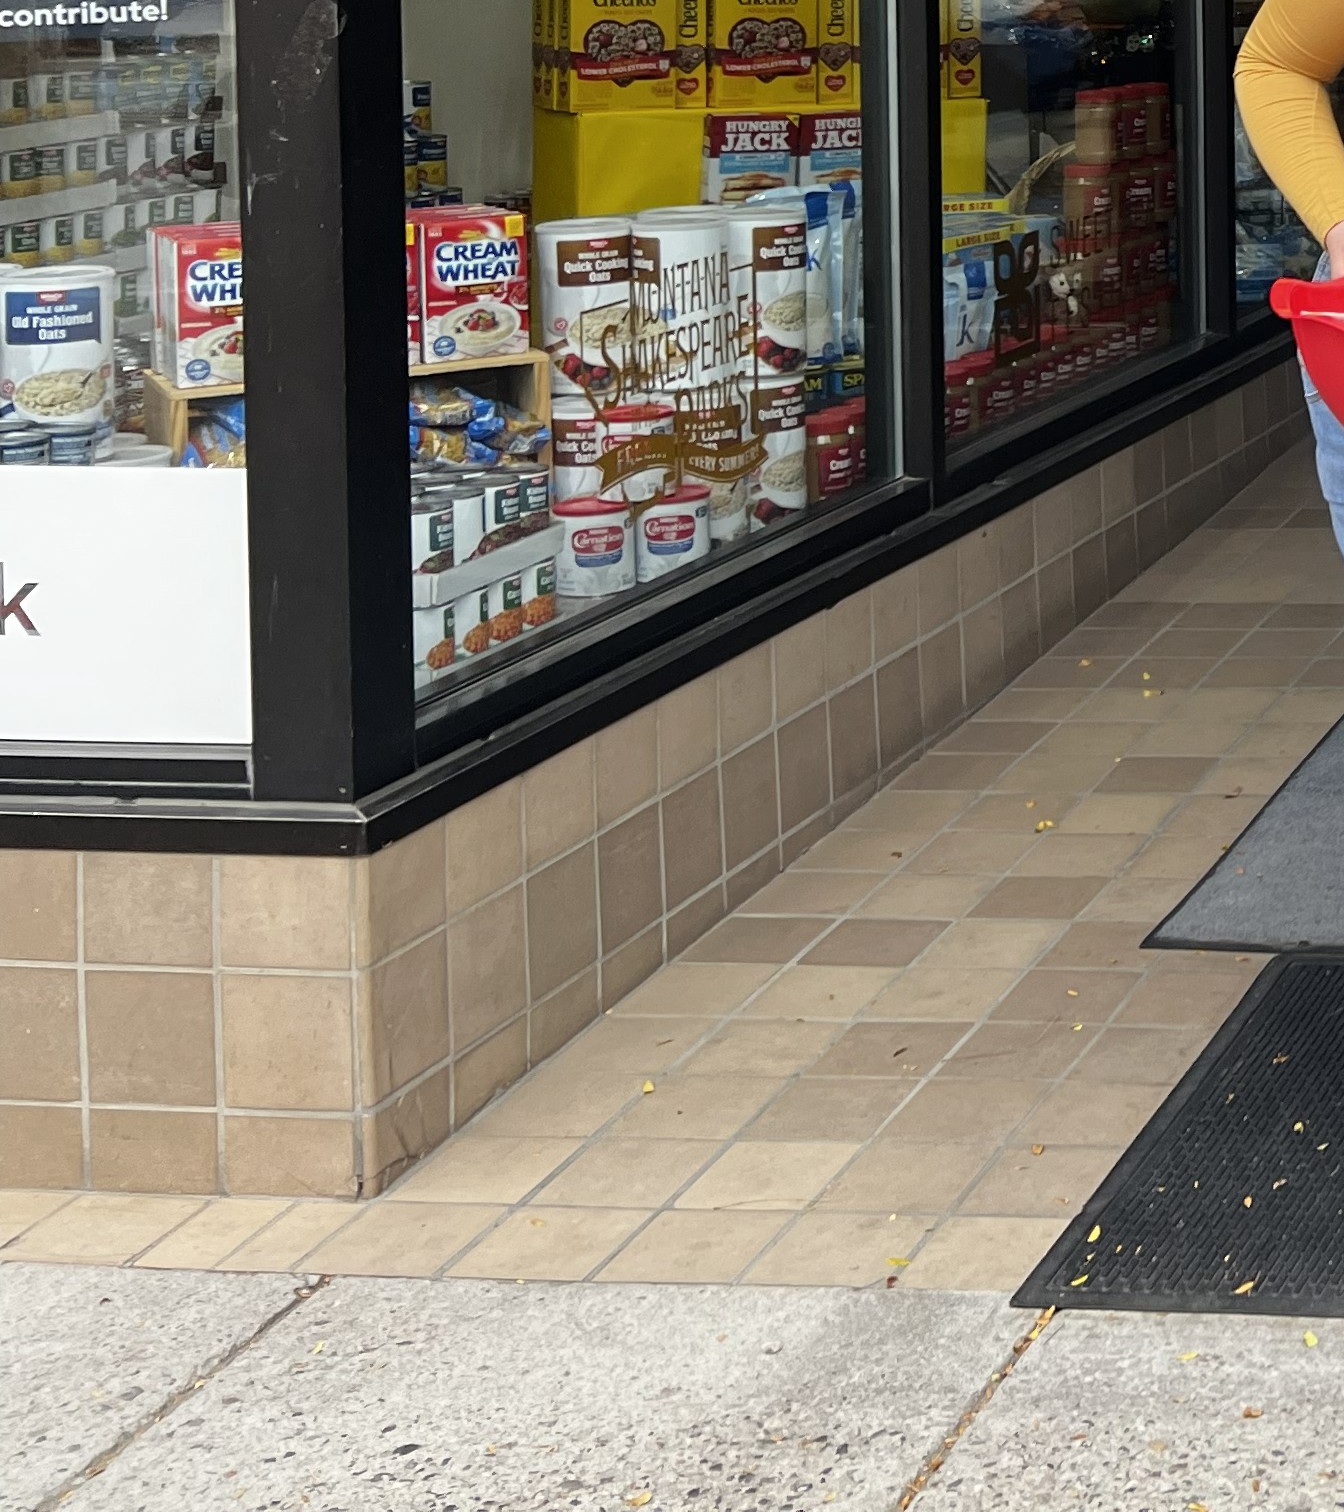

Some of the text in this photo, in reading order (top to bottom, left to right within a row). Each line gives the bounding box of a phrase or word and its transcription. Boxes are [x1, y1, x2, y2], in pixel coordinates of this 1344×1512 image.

[0, 0, 169, 28] contribute!
[725, 120, 789, 133] HUNGRY
[814, 117, 862, 131] HUNG
[721, 131, 791, 152] JACK
[812, 131, 862, 150] JAC
[435, 240, 519, 262] CREAM
[437, 259, 520, 282] WHEAT
[564, 260, 592, 273] Quick
[190, 282, 241, 302] WH
[11, 311, 93, 328] Old Fashioned
[38, 328, 67, 340] Oats
